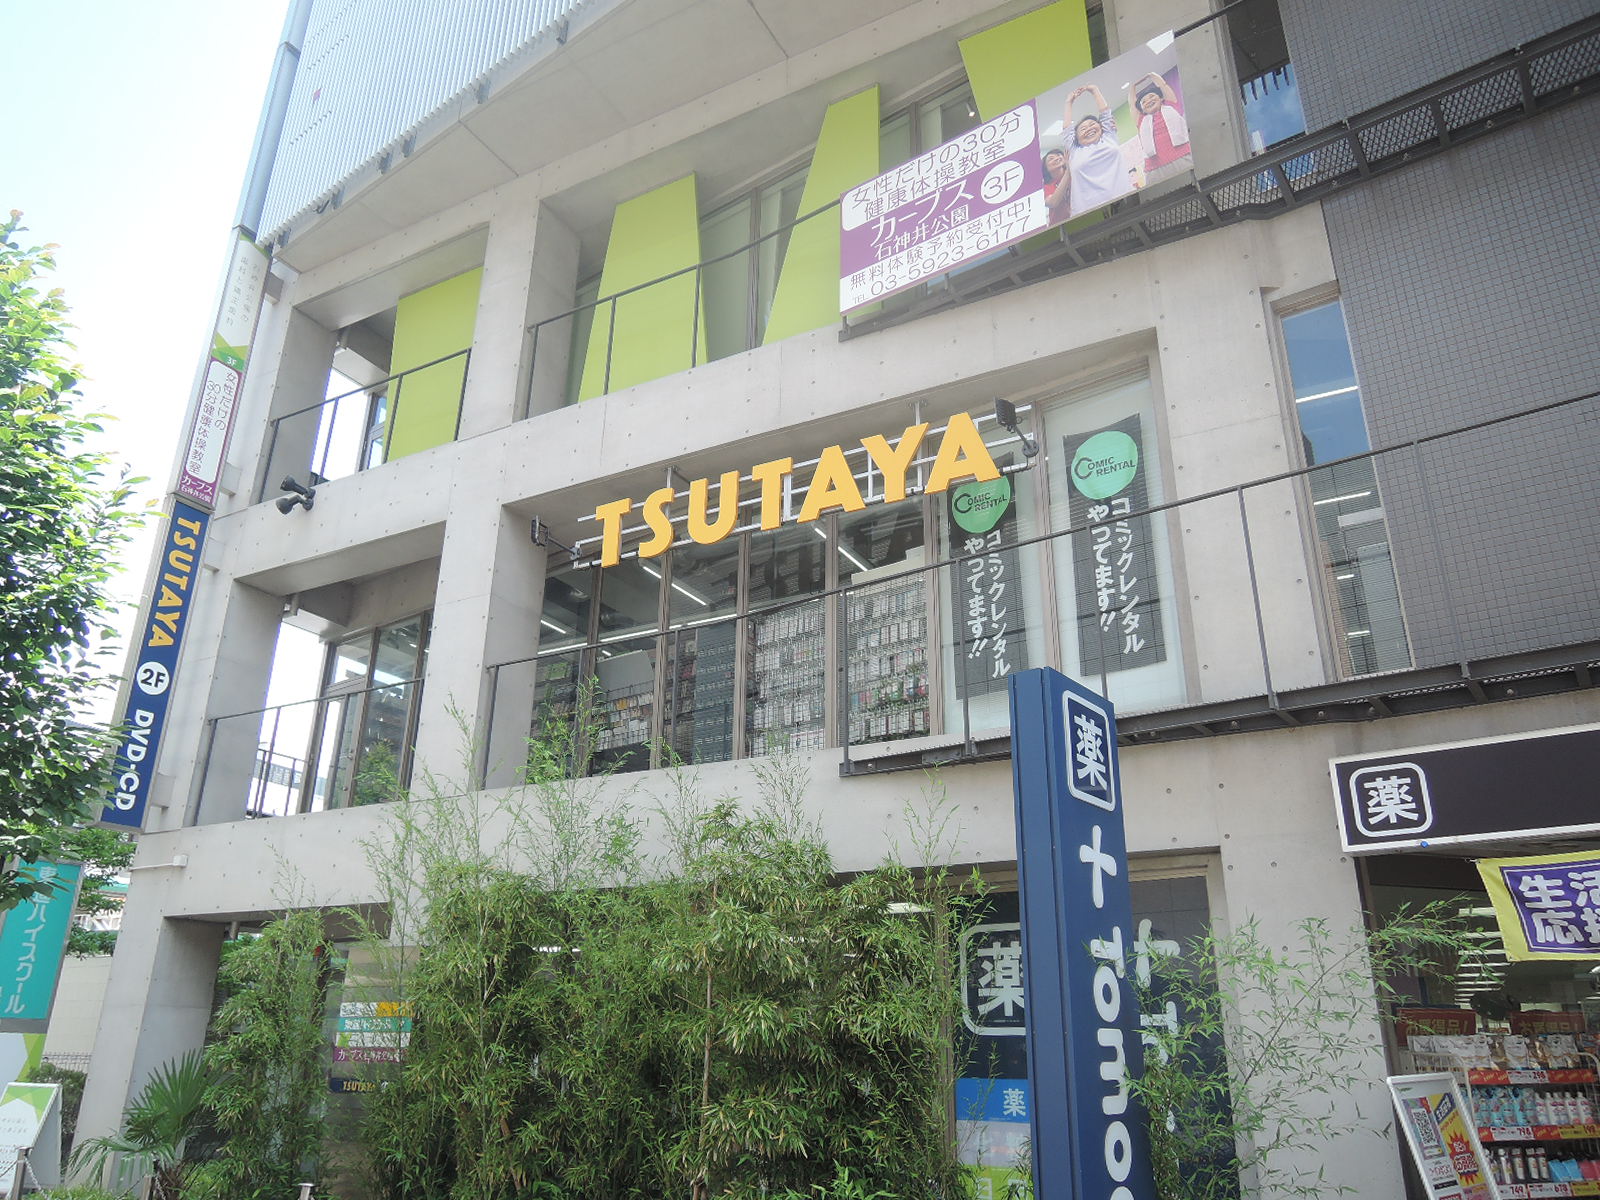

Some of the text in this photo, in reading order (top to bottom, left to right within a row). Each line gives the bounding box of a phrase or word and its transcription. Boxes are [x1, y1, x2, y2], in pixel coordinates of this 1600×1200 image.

[852, 111, 1021, 209] 女性だけの30分
[865, 138, 1006, 222] 健康体操教室
[983, 165, 1020, 200] 3F
[870, 179, 975, 247] カーブス
[874, 204, 969, 261] 石神井公園
[870, 215, 1031, 297] 03-5923-6177
[181, 475, 214, 496] カーブス
[595, 411, 1002, 569] TSUTAYA
[1074, 456, 1116, 480] COMIC
[1095, 459, 1136, 478] RENTAL
[953, 492, 992, 514] COMIC
[974, 494, 1008, 512] RENTAL
[148, 516, 201, 647] TSUTAYA
[986, 529, 1012, 678] コミックレンタル
[1111, 497, 1145, 654] コミックレンタル
[140, 668, 166, 690] 2F
[1073, 713, 1108, 791] 薬
[1363, 775, 1419, 825] 薬
[977, 940, 1025, 1017] 薬
[1003, 1088, 1026, 1117] 薬
